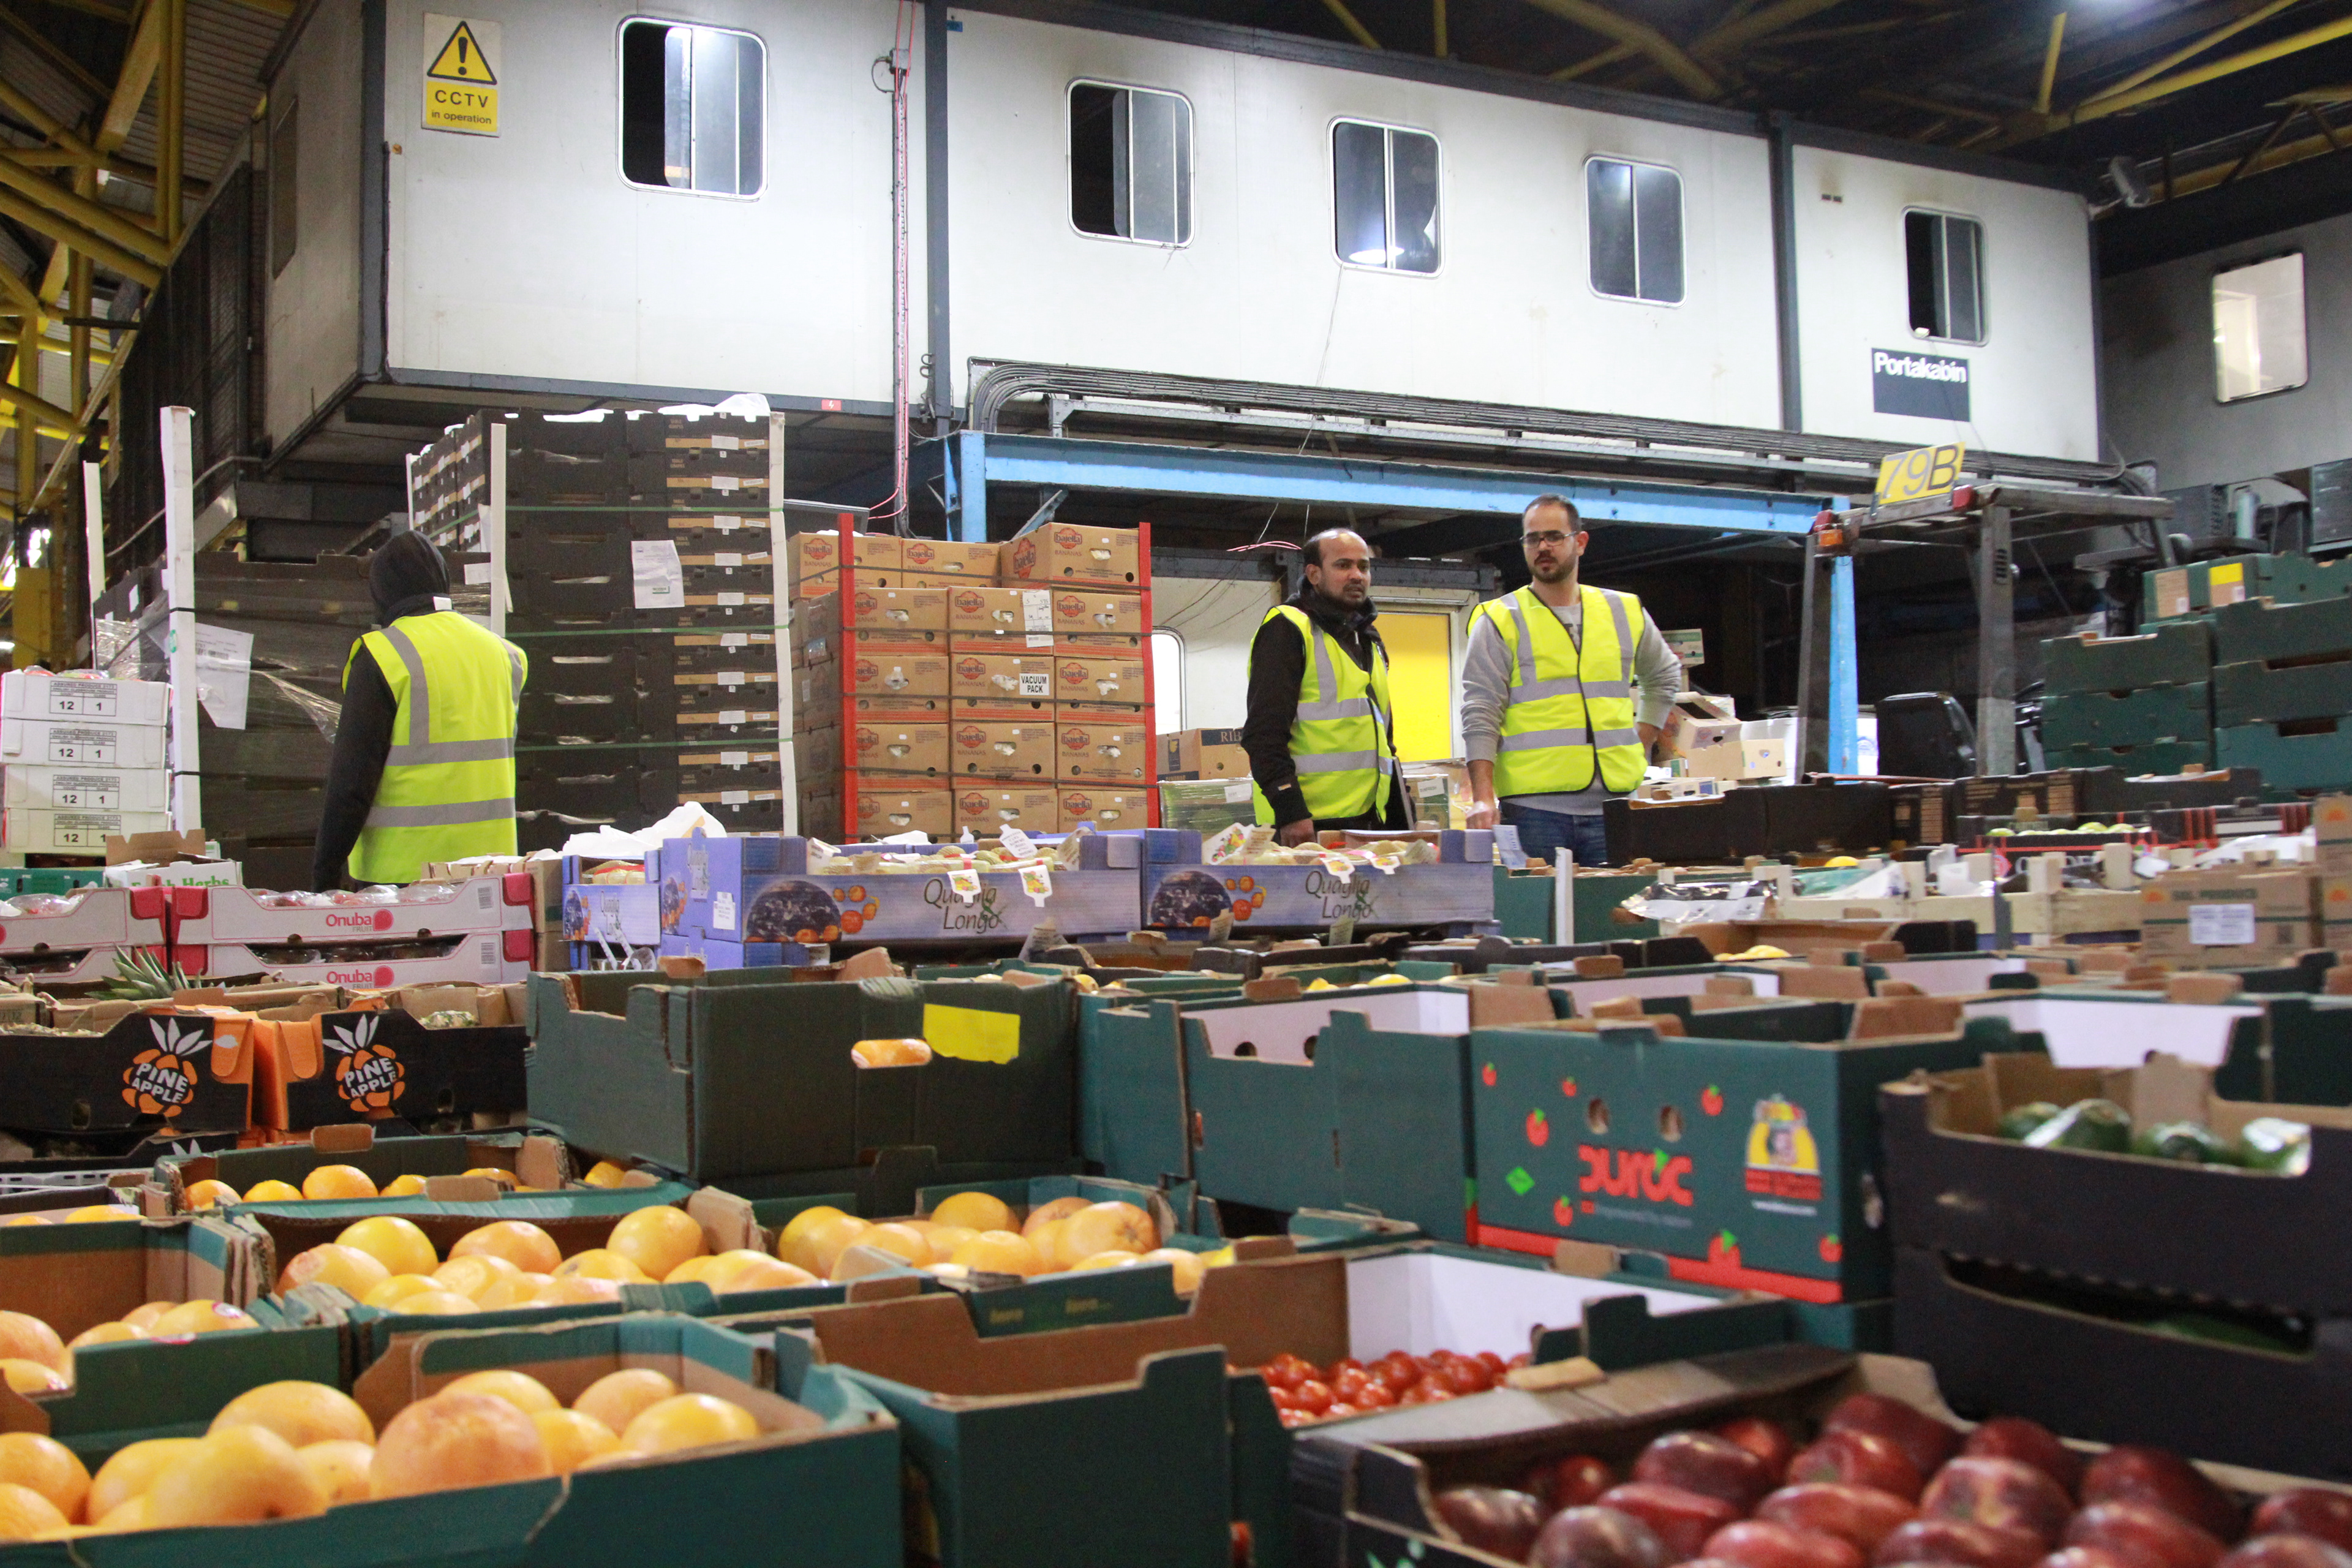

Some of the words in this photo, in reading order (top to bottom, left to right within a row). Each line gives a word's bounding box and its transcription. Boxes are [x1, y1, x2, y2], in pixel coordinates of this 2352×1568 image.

[435, 89, 489, 108] CCTV
[431, 110, 440, 118] in
[443, 113, 492, 124] operation
[1874, 352, 1967, 383] Portakabin
[1882, 444, 1959, 499] 79B
[1020, 676, 1047, 684] VACUUM
[1027, 685, 1043, 693] PACK
[59, 701, 74, 710] 12
[59, 748, 74, 757] 12
[62, 794, 77, 803] 12
[64, 834, 78, 842] 12
[1322, 896, 1372, 923] Longo
[326, 913, 372, 927] Onuba
[943, 905, 1000, 934] Longo
[326, 969, 373, 984] Onuba
[135, 1063, 189, 1093] PINE
[345, 1057, 395, 1088] PINE
[130, 1079, 183, 1103] APPLE
[350, 1070, 397, 1098] APPLE
